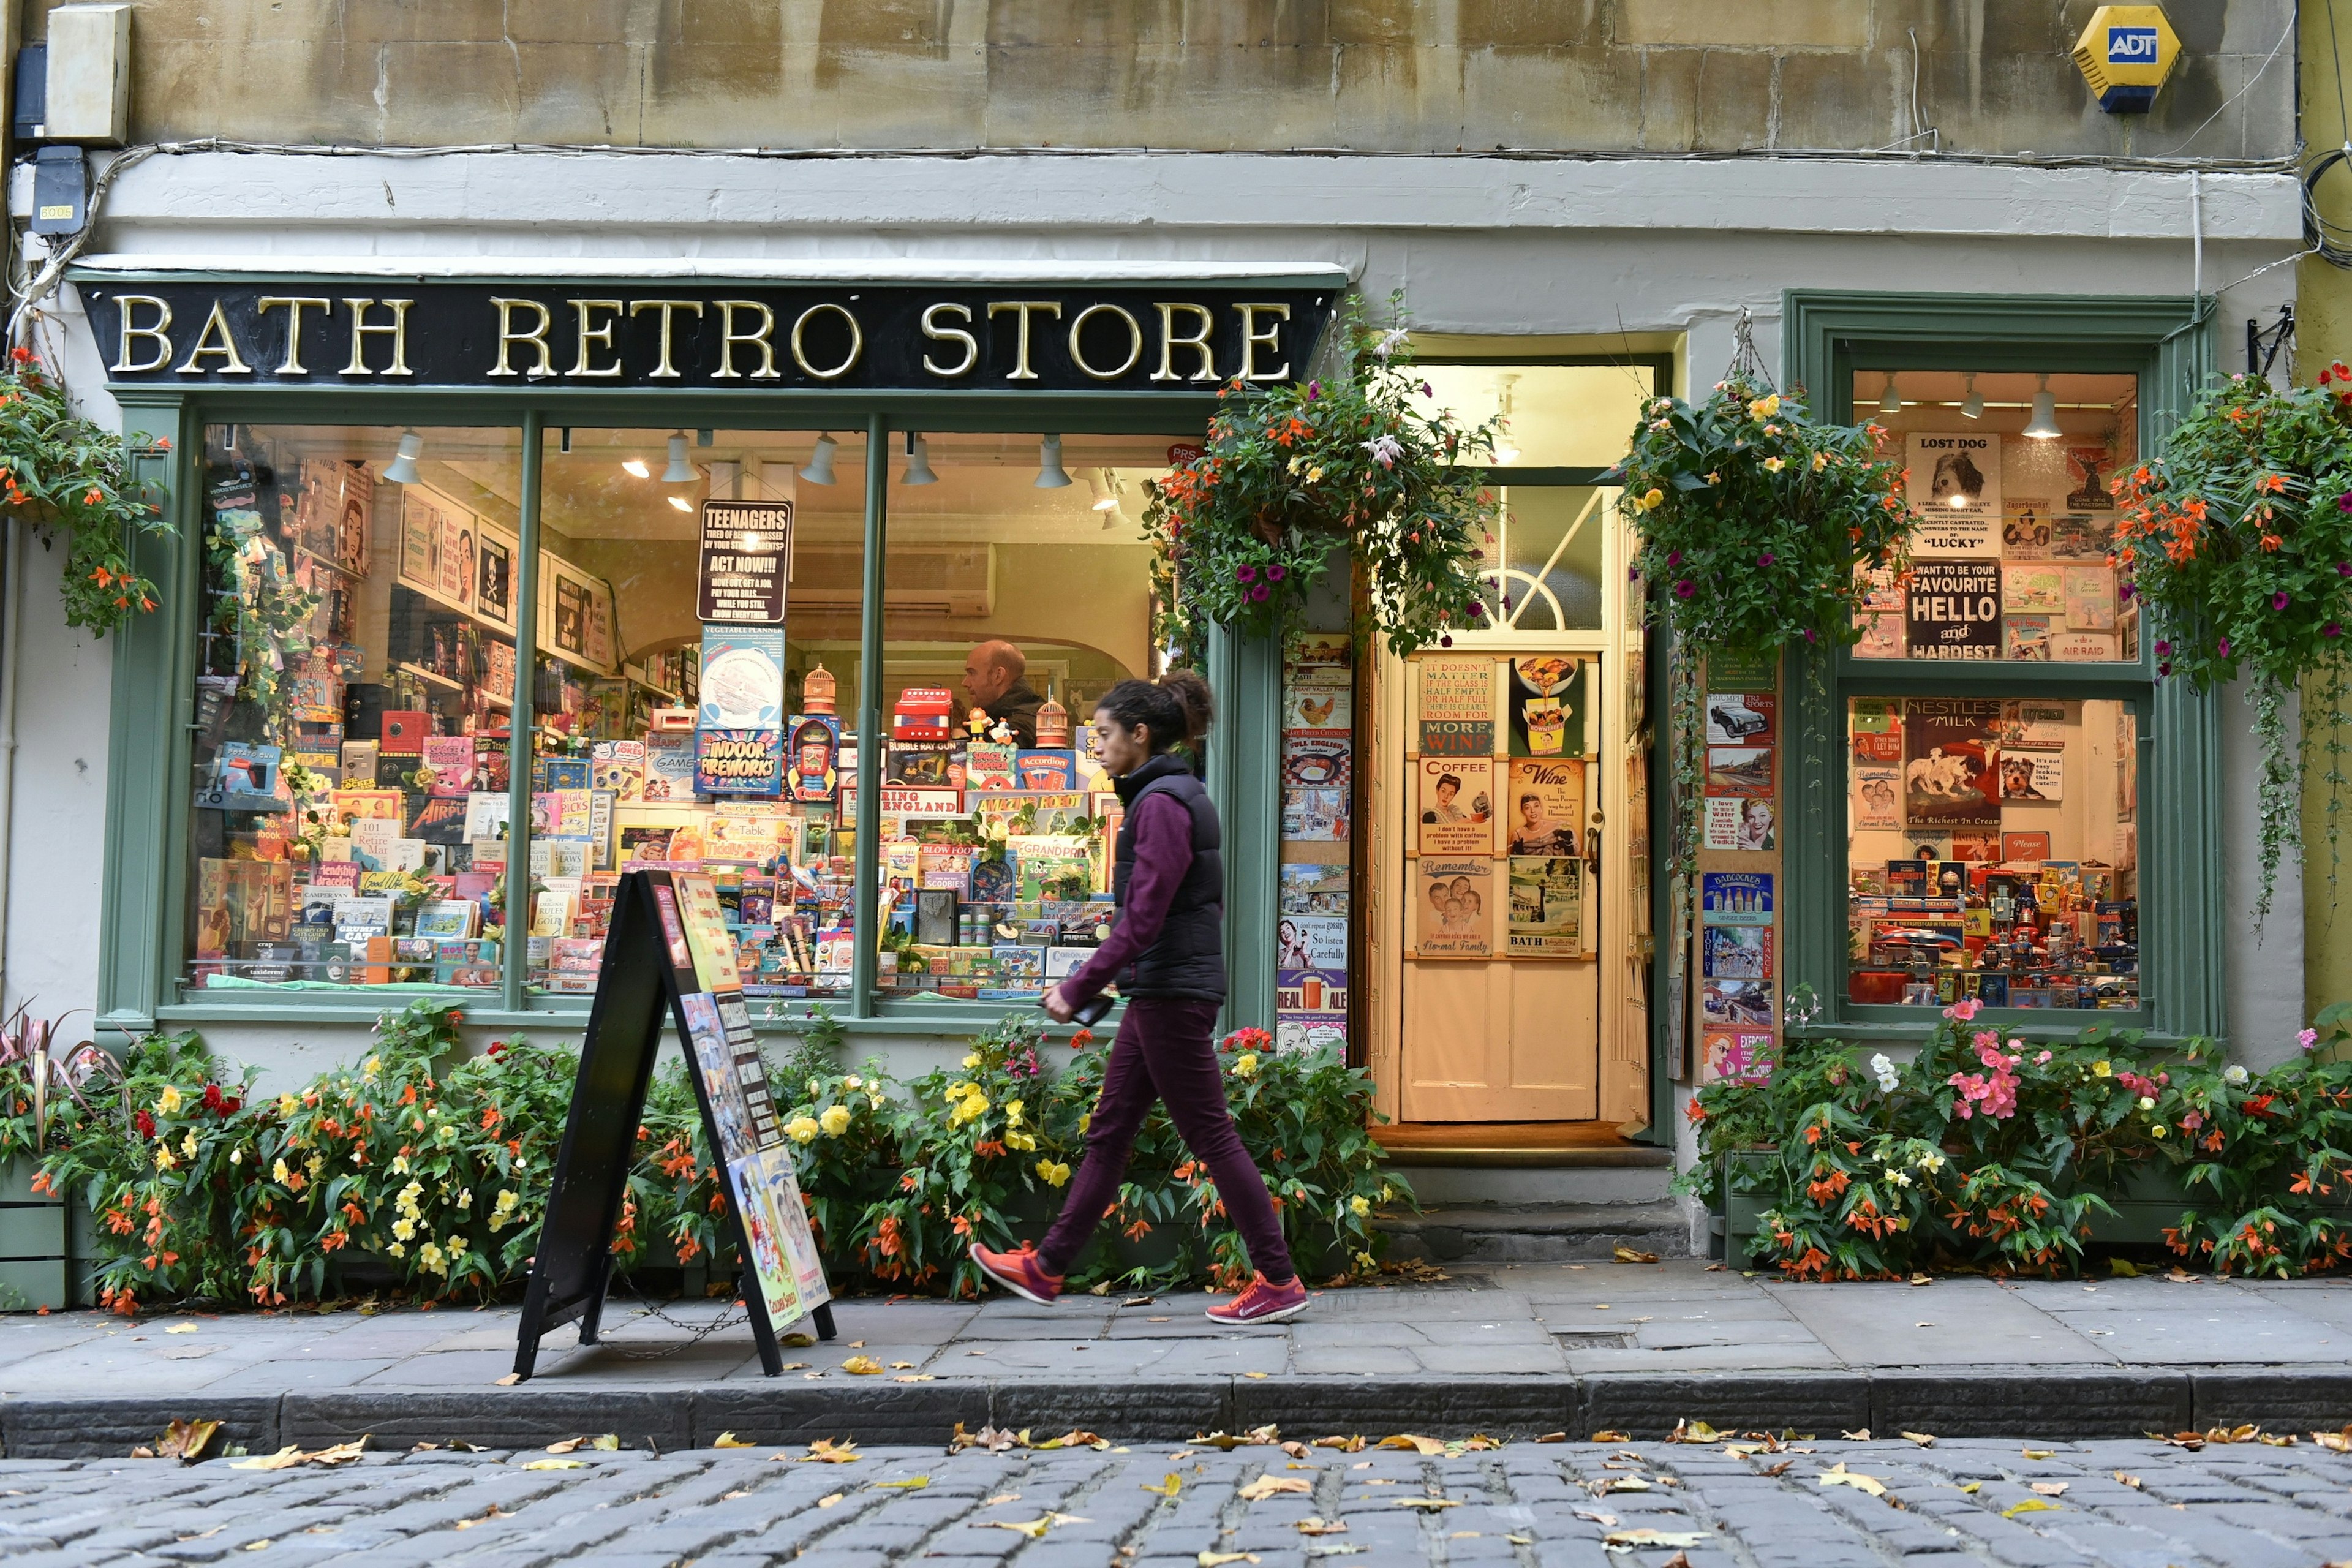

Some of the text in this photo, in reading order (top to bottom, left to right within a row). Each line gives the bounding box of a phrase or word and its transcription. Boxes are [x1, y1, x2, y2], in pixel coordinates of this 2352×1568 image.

[2109, 34, 2155, 56] ADT
[41, 207, 72, 218] 6005
[110, 295, 1290, 380] BATH RETRO STORE
[1921, 439, 1988, 448] LOST DOG
[1173, 448, 1196, 459] PRS
[209, 482, 253, 496] MOUSTACHES
[706, 509, 786, 530] TEENAGERS
[710, 556, 777, 573] ACT NOW!!!
[1917, 566, 1941, 575] WANT
[1943, 566, 1955, 575] TO
[1958, 566, 1969, 575] BE
[1972, 566, 1995, 575] YOUR
[1911, 577, 1996, 593] FAVOURITE
[717, 600, 765, 609] WHILE YOU STILL
[1912, 597, 1996, 622] HELLO
[712, 610, 769, 620] KNOW EVERYTHING
[1912, 645, 1996, 660] HARDEST
[2021, 708, 2065, 720] KITCHEN
[1936, 716, 1976, 726] MILK
[1426, 723, 1488, 733] MORE
[318, 736, 339, 745] RACE
[1311, 741, 1343, 750] ENGLISH
[1426, 734, 1488, 750] WINE
[430, 745, 460, 755] SPACE
[616, 747, 643, 755] JOKES
[710, 741, 766, 759] INDOOR
[889, 742, 918, 751] BUBBLE
[921, 742, 936, 751] RAY
[227, 748, 276, 760] POTATO GUN
[972, 752, 1001, 761] SPACE
[430, 755, 466, 765] HOPPER
[1023, 755, 1066, 767] Accordion
[701, 757, 774, 777] FIREWORKS
[972, 761, 1008, 771] HOPPER
[1426, 761, 1487, 775] COFFEE
[1523, 764, 1570, 785] Wine
[341, 778, 376, 790] LOCKER
[1737, 787, 1758, 796] SCOTSMAN
[883, 802, 956, 812] ENGLAND
[979, 793, 1081, 812] AMAZING ROBOT
[264, 820, 281, 829] 60s
[1908, 815, 1924, 824] The
[363, 823, 380, 832] 101
[739, 825, 766, 836] Table
[706, 842, 766, 856] Tiddlywinks
[2013, 839, 2041, 848] Please
[1024, 844, 1086, 858] GRAND PRIX
[1422, 859, 1492, 875] Remember
[316, 875, 353, 886] Bracelets
[364, 872, 403, 889] Good Wife
[345, 932, 372, 941] CAT
[1313, 933, 1343, 944] So listen
[1510, 937, 1542, 946] BATH
[1423, 940, 1487, 954] Normal Family
[946, 950, 983, 962] LUDO
[1311, 948, 1344, 962] Carefully
[1705, 961, 1711, 971] DE
[1278, 992, 1346, 1009] REAL ALE
[769, 1292, 797, 1315] GOLDEN SHRED
